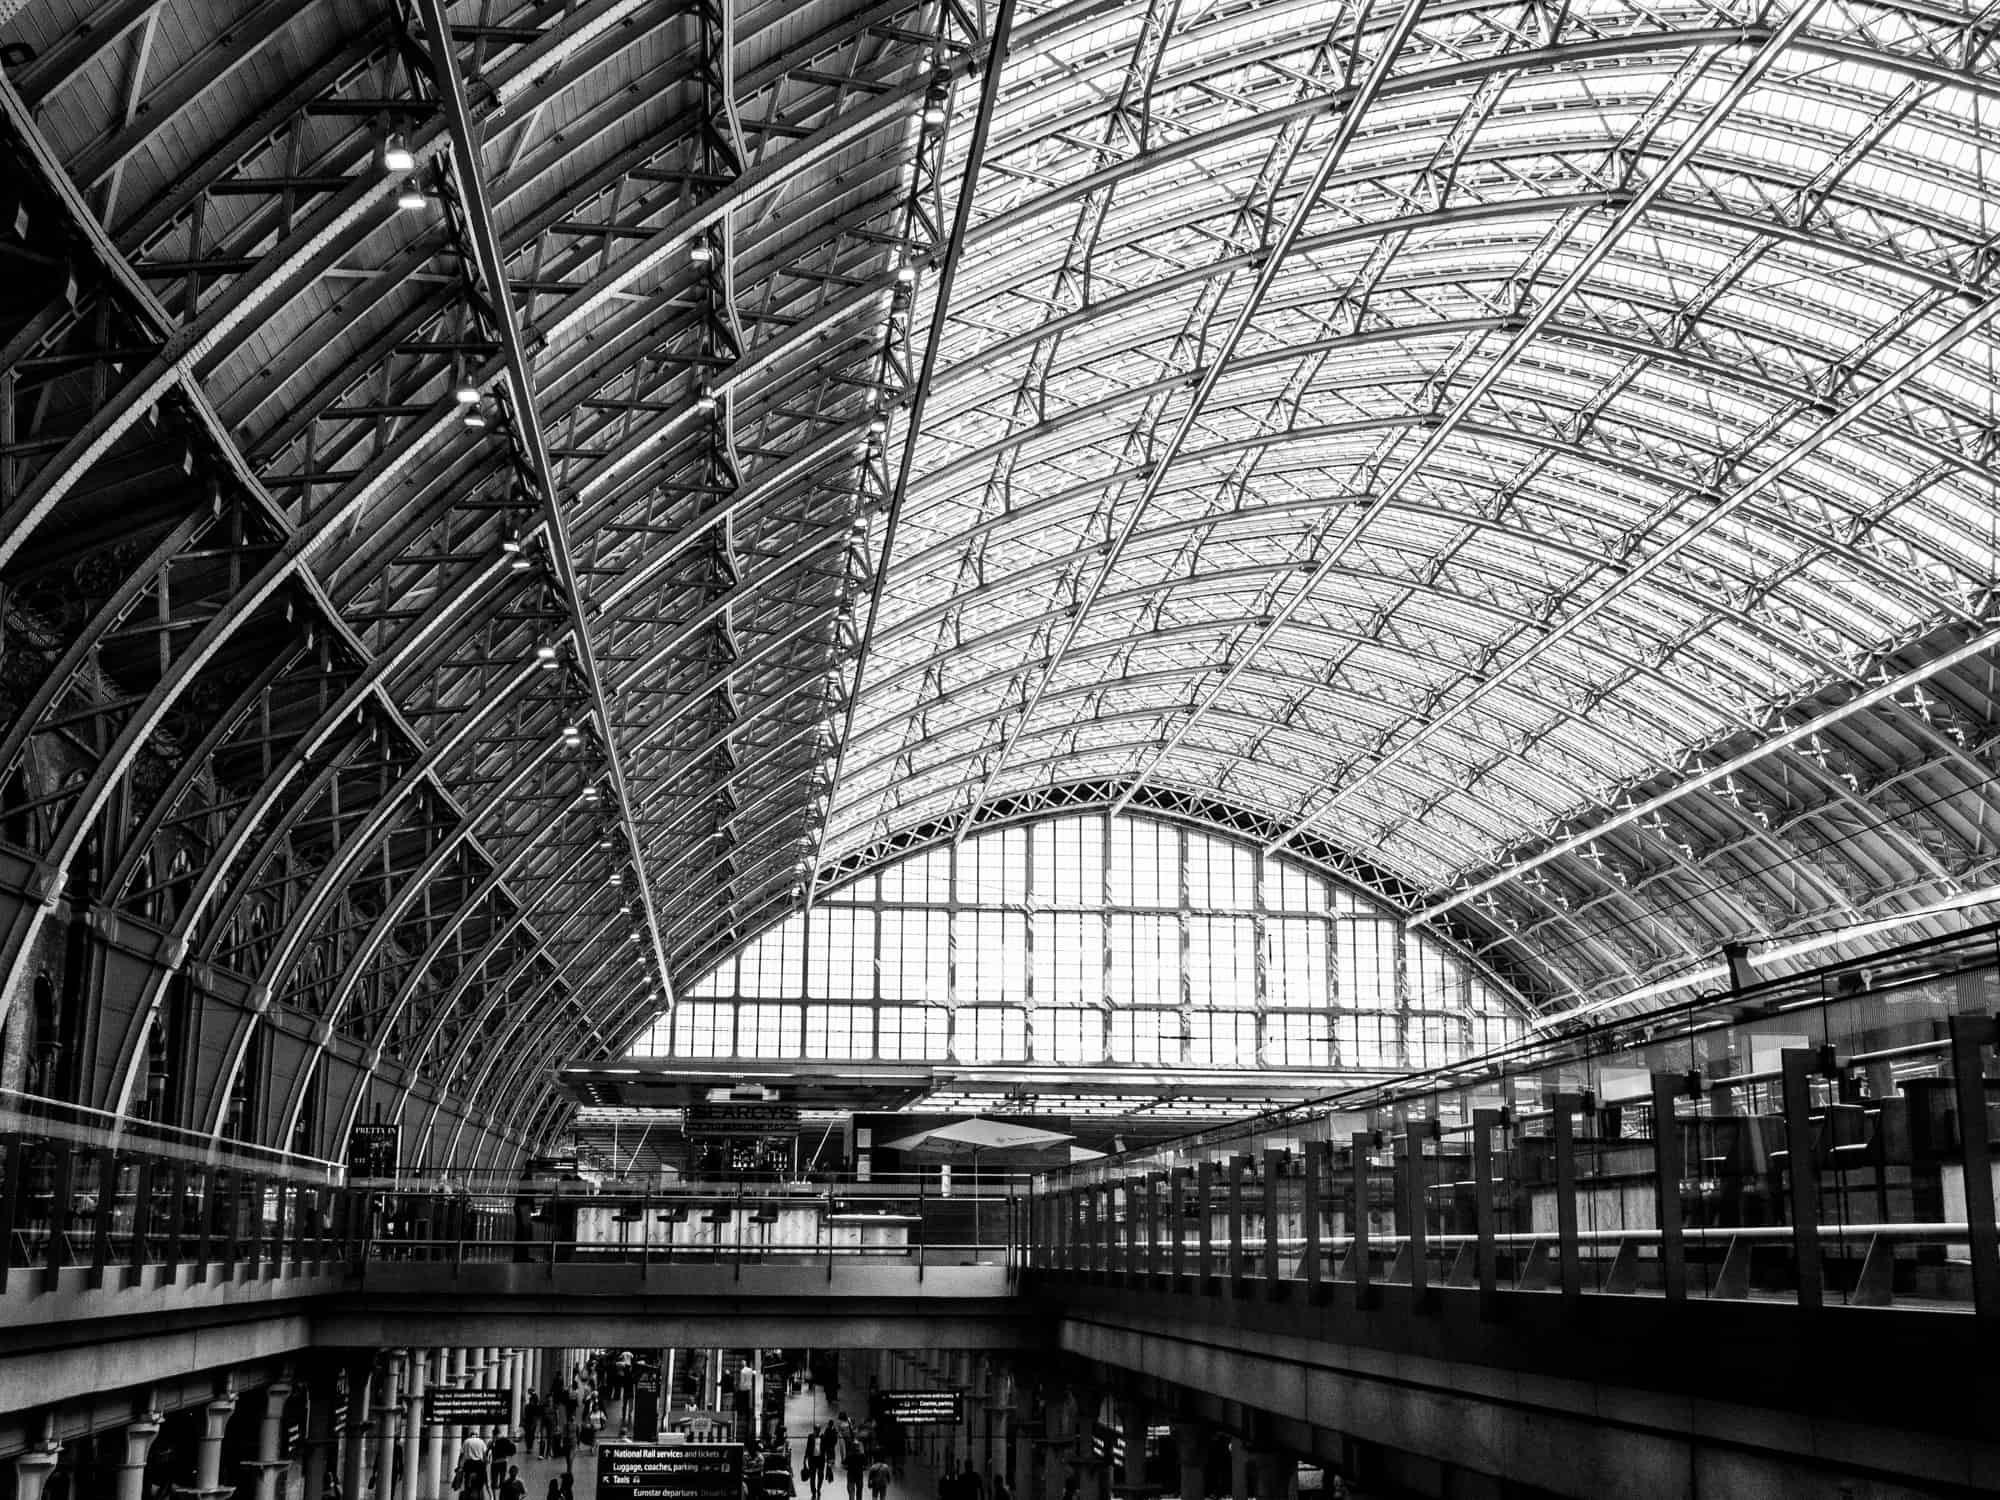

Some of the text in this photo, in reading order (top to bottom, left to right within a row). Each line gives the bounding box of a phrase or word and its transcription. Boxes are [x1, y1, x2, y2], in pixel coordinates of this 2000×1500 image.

[692, 1105, 794, 1119] SEARCYS
[355, 1127, 396, 1135] PRETTY IN
[613, 1449, 720, 1458] National Rail services and tickets
[613, 1463, 699, 1472] Luggage, coaches, parking
[613, 1475, 630, 1484] Taxis
[633, 1488, 661, 1497] Eurostar
[662, 1488, 698, 1499] departures
